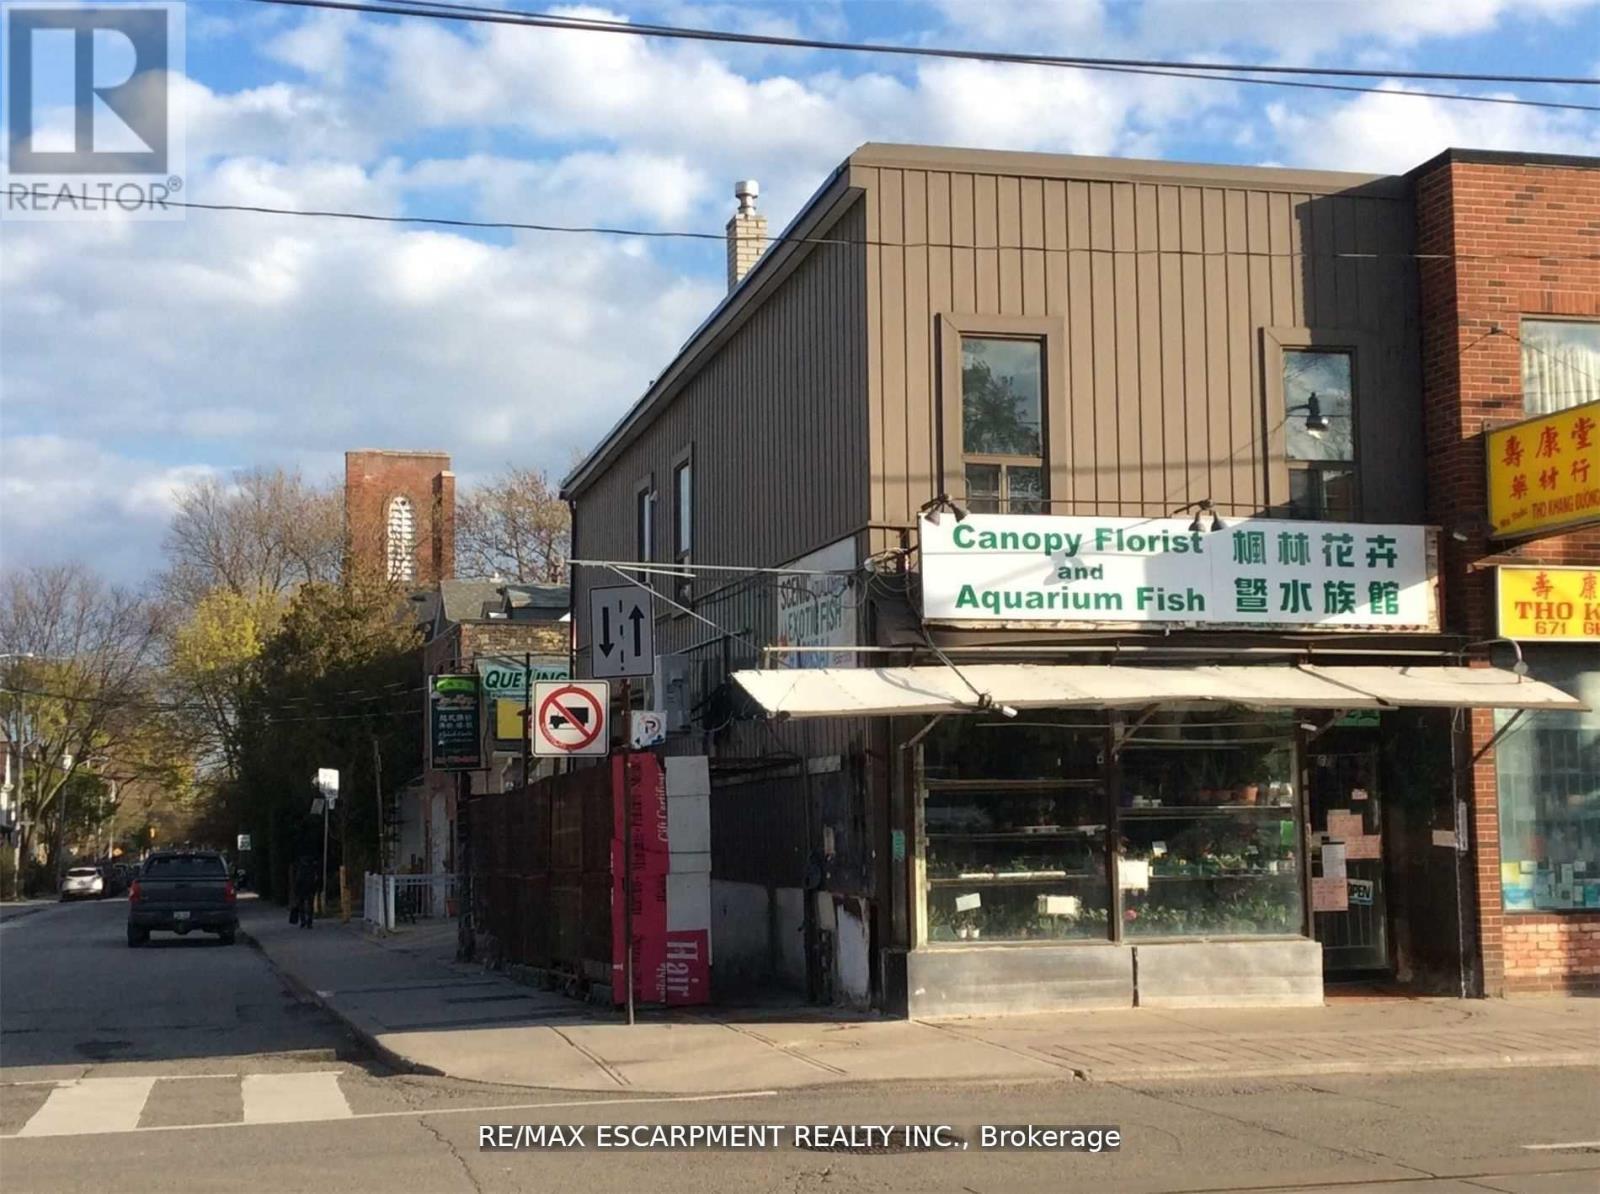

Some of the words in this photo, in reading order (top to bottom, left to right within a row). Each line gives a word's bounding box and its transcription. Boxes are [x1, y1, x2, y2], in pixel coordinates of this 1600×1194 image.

[953, 524, 1082, 557] Canopy
[1095, 528, 1204, 553] Florist
[1232, 530, 1398, 568] 楓林花卉
[1057, 563, 1103, 580] and
[954, 585, 1122, 614] Aquarium
[1136, 587, 1205, 611] Fish
[1234, 577, 1400, 615] 暨水族館
[1514, 602, 1573, 620] THO
[1535, 621, 1567, 635] 671
[667, 941, 698, 997] Hair
